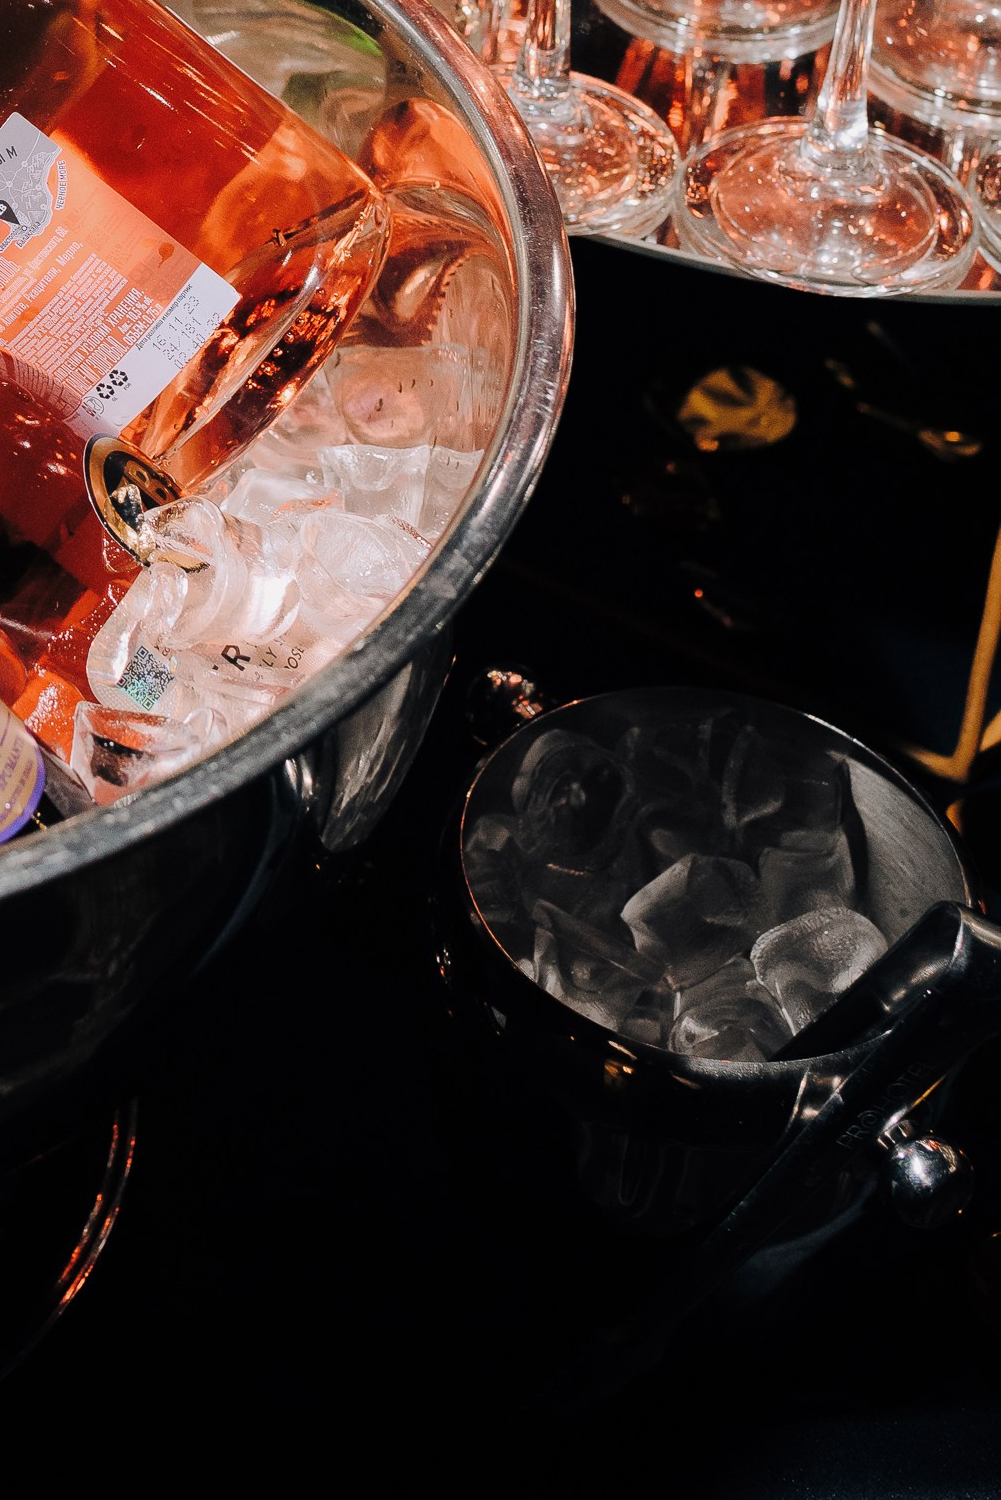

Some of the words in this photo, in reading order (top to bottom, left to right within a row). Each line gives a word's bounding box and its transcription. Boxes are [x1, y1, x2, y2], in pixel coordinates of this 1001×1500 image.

[56, 180, 67, 208] ЧЕРНОЕ
[0, 298, 29, 326] Алиготе,
[22, 263, 61, 302] Ркацители,
[55, 238, 84, 266] Мерло,
[125, 306, 143, 323] 10,5
[141, 305, 161, 324] 0,75
[181, 294, 200, 314] 23
[79, 322, 112, 355] УСЛОВИЙ
[106, 285, 144, 327] ХРАНЕНИЯ.
[85, 332, 129, 376] ЗДОРОВЬЮ.
